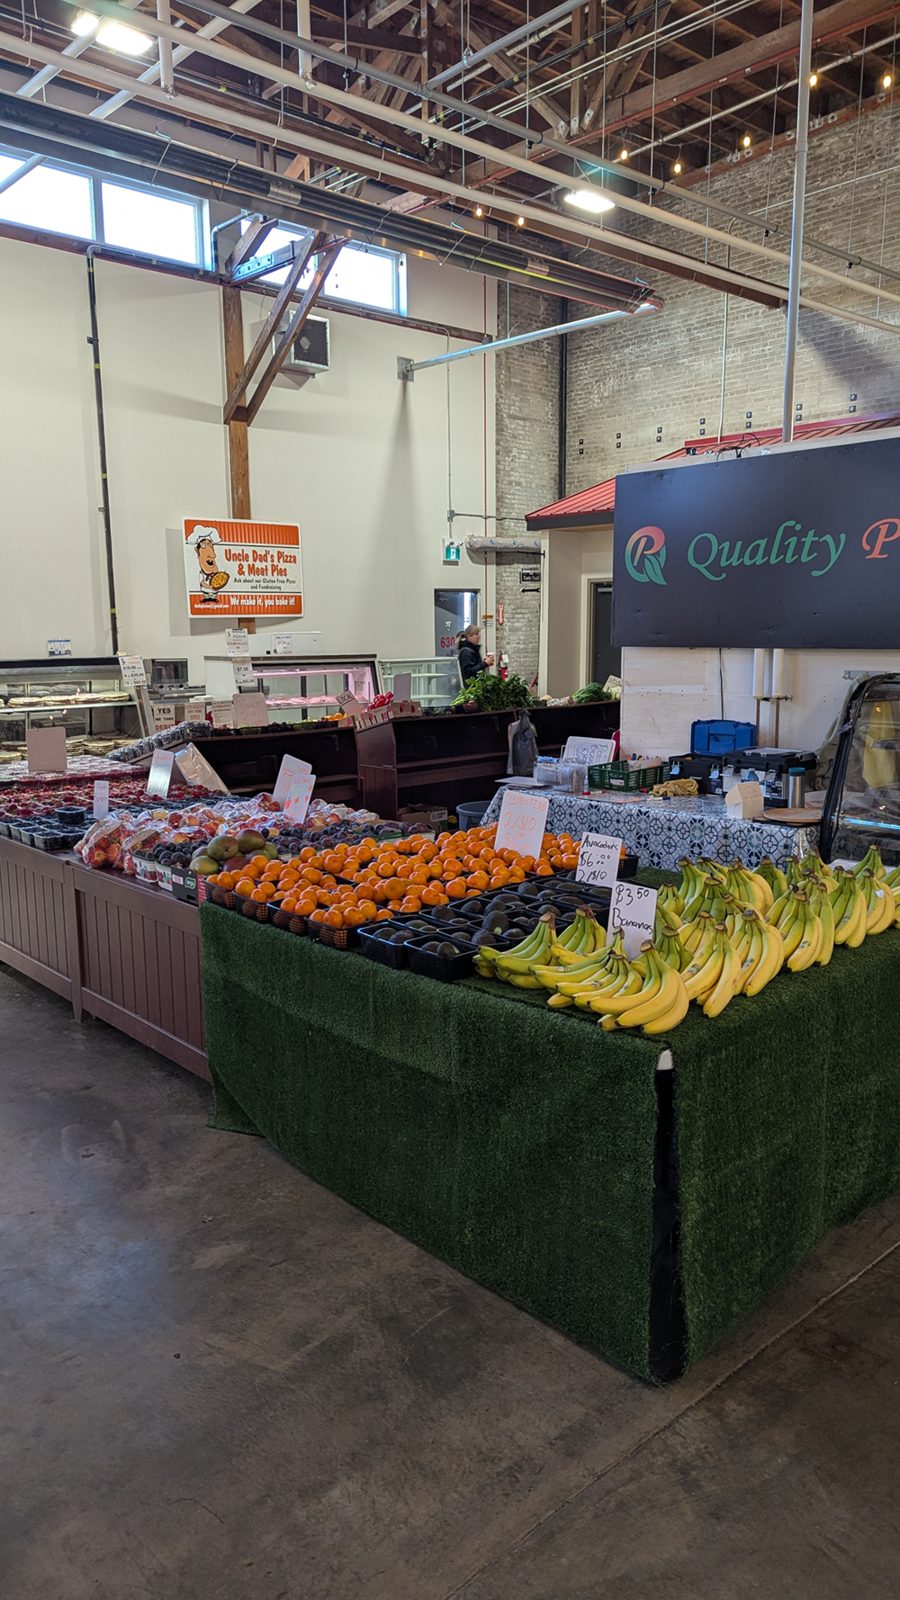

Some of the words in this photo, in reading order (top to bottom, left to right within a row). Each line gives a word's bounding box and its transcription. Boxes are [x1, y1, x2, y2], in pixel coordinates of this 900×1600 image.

[224, 549, 249, 563] Uncle
[252, 549, 274, 563] Dad's
[277, 550, 297, 565] Pizza
[687, 520, 846, 581] Quality
[237, 563, 245, 576] &
[247, 564, 269, 577] Meat
[270, 564, 288, 577] Pies
[231, 595, 239, 606] We
[241, 596, 256, 606] make
[265, 599, 275, 608] you
[275, 596, 288, 606] bake
[612, 907, 654, 935] Bananas
